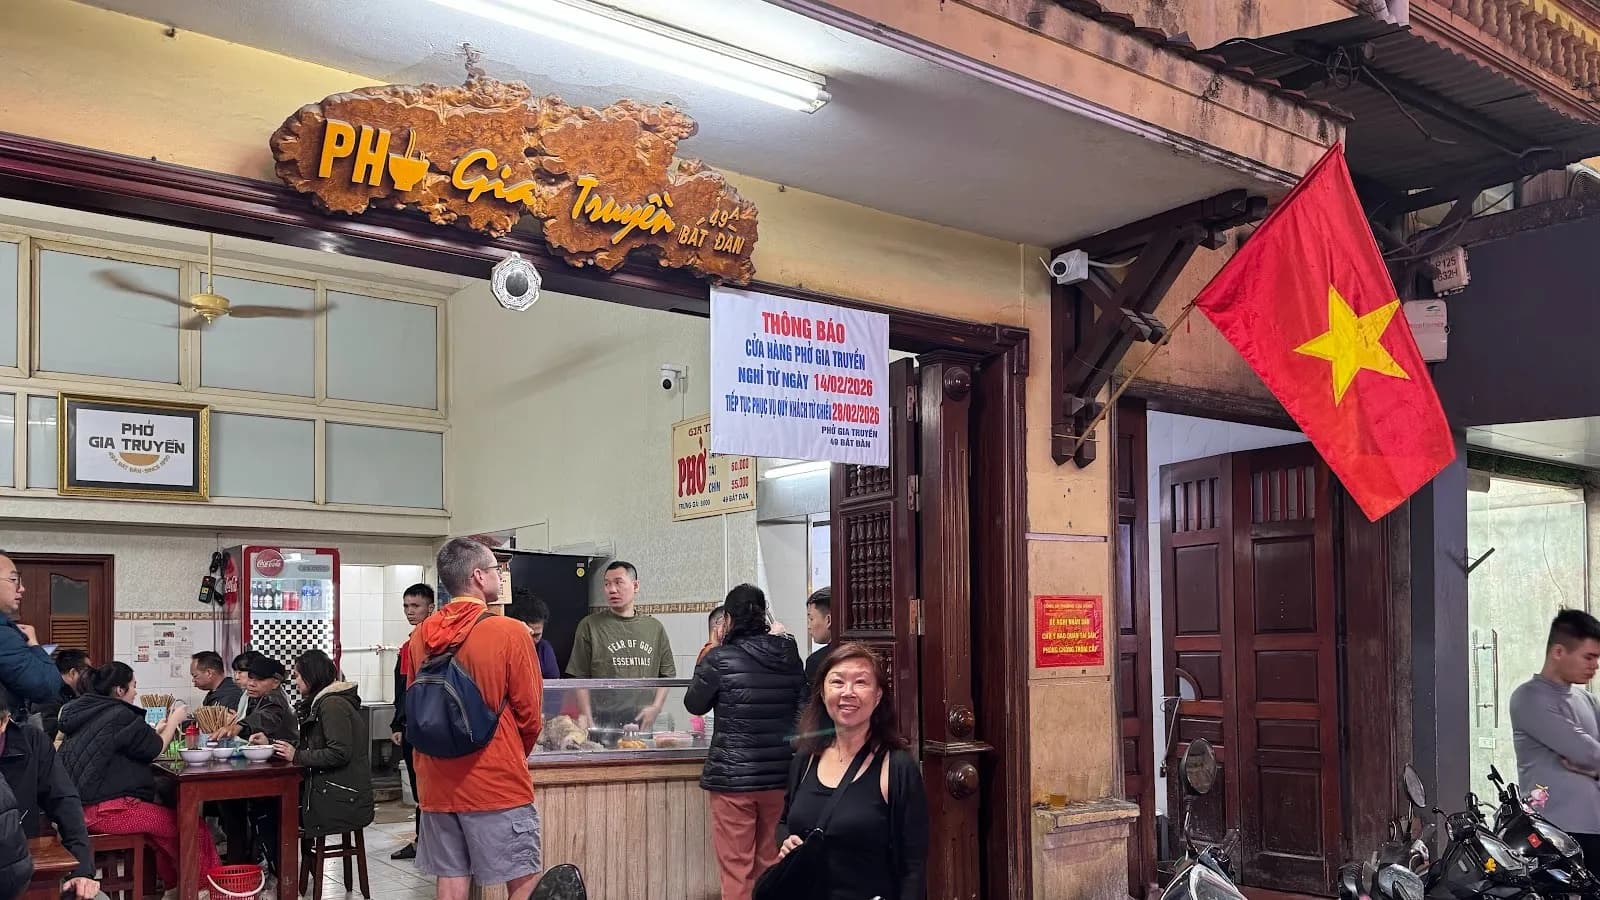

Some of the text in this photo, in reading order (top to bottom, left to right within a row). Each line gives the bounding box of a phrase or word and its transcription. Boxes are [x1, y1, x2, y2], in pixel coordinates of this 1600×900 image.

[452, 149, 537, 205] Gia
[571, 178, 676, 245] Truyền
[709, 206, 740, 228] 49A
[762, 310, 845, 344] THÔNG BÁO
[745, 332, 764, 358] CỬA
[767, 339, 792, 362] HÀNG
[795, 340, 813, 364] PHỞ
[815, 353, 831, 367] GIA
[738, 363, 873, 397] NGHỈ TỪ NGÀY 14/02/2026
[725, 389, 739, 412] TIẾP
[740, 395, 751, 416] TỤC
[752, 397, 768, 419] PHỤC
[769, 398, 777, 419] VỤ
[777, 396, 788, 417] QUÝ
[789, 398, 808, 419] KHÁCH
[808, 399, 816, 419] TỪ
[832, 402, 880, 425] 28/02/2026
[121, 419, 154, 437] PHỞ
[821, 424, 837, 435] PHỞ
[837, 427, 850, 437] GIA
[88, 436, 116, 450] GIA
[677, 436, 707, 498] PHỞ
[608, 639, 653, 654] FEAR OF GOD
[612, 657, 650, 666] ESSENTIALS
